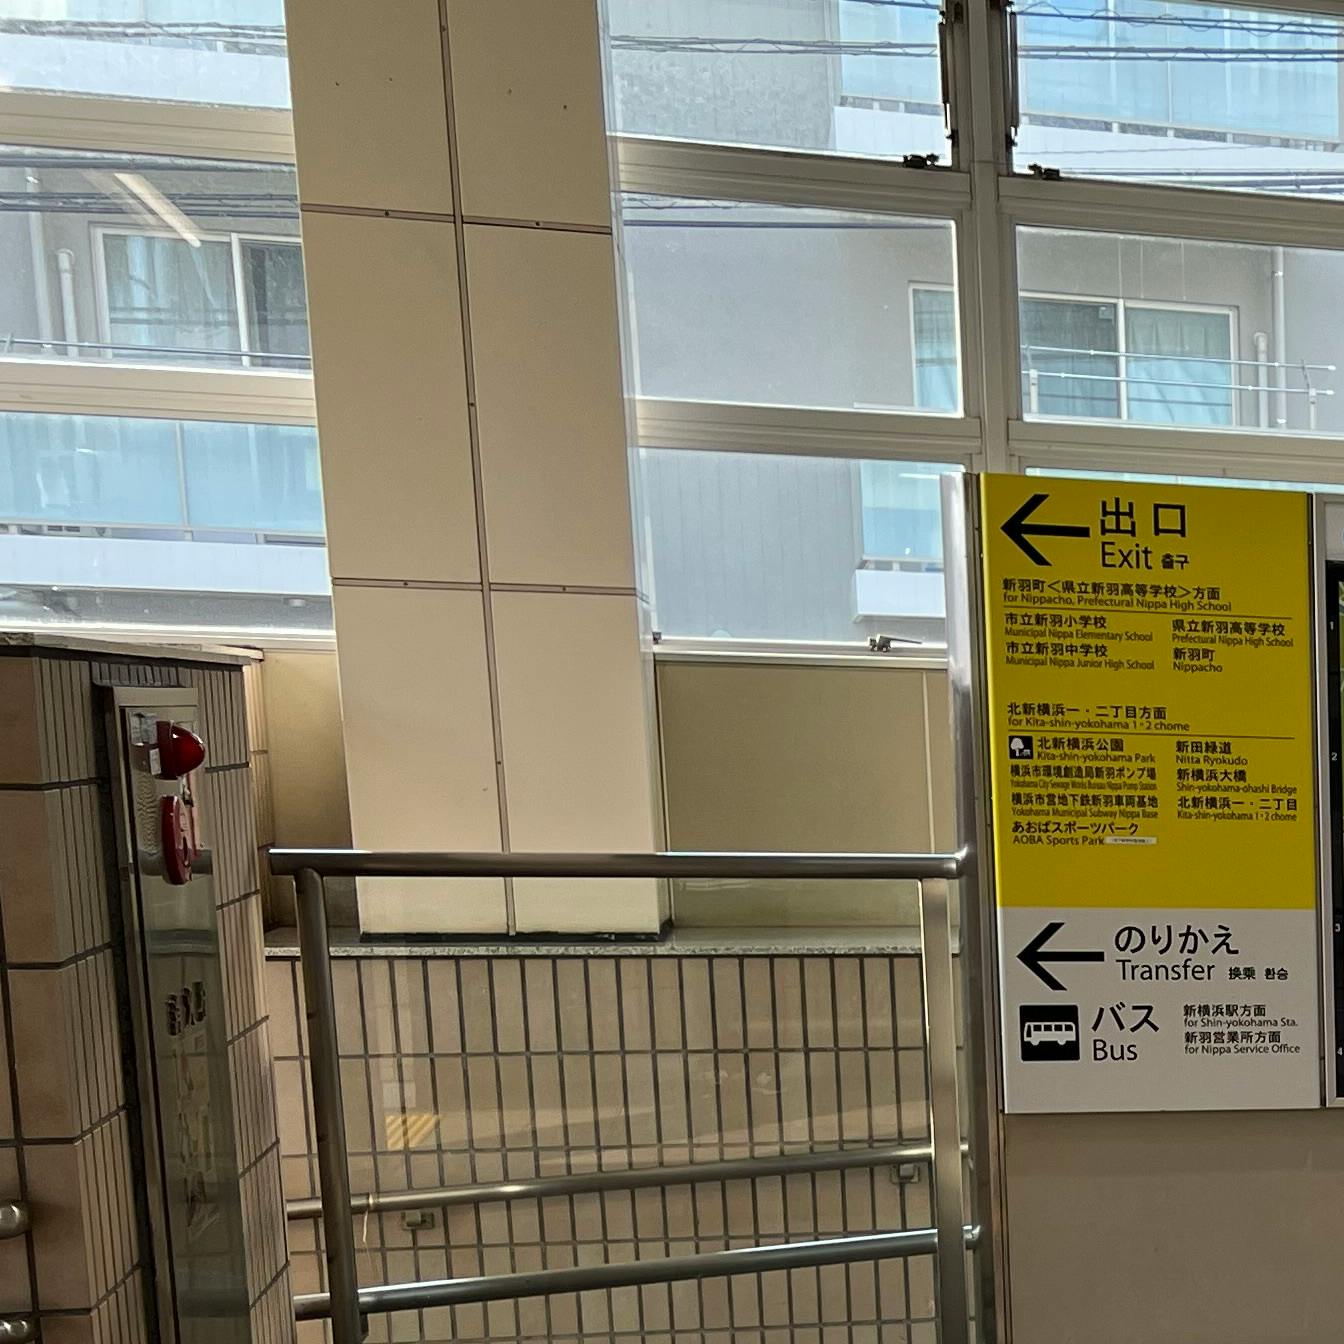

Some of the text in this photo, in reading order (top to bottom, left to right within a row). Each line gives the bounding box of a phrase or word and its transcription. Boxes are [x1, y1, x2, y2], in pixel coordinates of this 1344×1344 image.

[1100, 497, 1187, 538] 出口
[1100, 542, 1153, 570] Exit
[1004, 593, 1018, 602] for
[1078, 596, 1134, 608] Prefectural
[1137, 598, 1168, 611] Nippa
[1170, 599, 1194, 612] High
[1198, 600, 1232, 612] School
[1005, 612, 1107, 629] 市立新羽小学校
[1005, 628, 1153, 643] Municipal Nippa Elementary School
[1172, 620, 1285, 638] 県立新羽高等学校
[1172, 634, 1294, 648] Prefectural Nippa High School
[1006, 642, 1108, 658] 市立新羽中学校
[1173, 648, 1215, 662] 新羽町
[1006, 656, 1155, 671] Municipal Nippa Junior High School
[1173, 662, 1222, 673] Nippacho
[1008, 703, 1167, 720] 北新横浜一・二丁目方面
[1008, 716, 1023, 726] for
[1026, 718, 1129, 730] Kita-shin-yokohama
[1154, 722, 1190, 732] chome
[1038, 737, 1124, 752] 北新横浜公園
[1176, 740, 1232, 755] 新田緑道
[1037, 752, 1156, 764] Kita-shin-yokohama Park
[1176, 756, 1248, 768] Nitta Ryokudo
[1331, 752, 1338, 761] 2
[1177, 768, 1246, 783] 新横浜大橋
[1271, 784, 1297, 796] Bridge
[1178, 796, 1297, 811] 北新横浜一・二丁目
[1012, 836, 1044, 846] AOBA
[1046, 836, 1080, 847] Sports
[1082, 836, 1104, 846] Park
[1114, 925, 1240, 955] のりかえ
[1115, 958, 1216, 981] Transfer
[1092, 1002, 1160, 1033] バス
[1184, 1004, 1266, 1017] 新横浜駅方面
[1184, 1018, 1298, 1030] for Shin-yokohama Sta.
[1185, 1030, 1281, 1044] 新羽営業所方面
[1092, 1039, 1138, 1061] Bus
[1185, 1044, 1300, 1056] for Nippa Service Office
